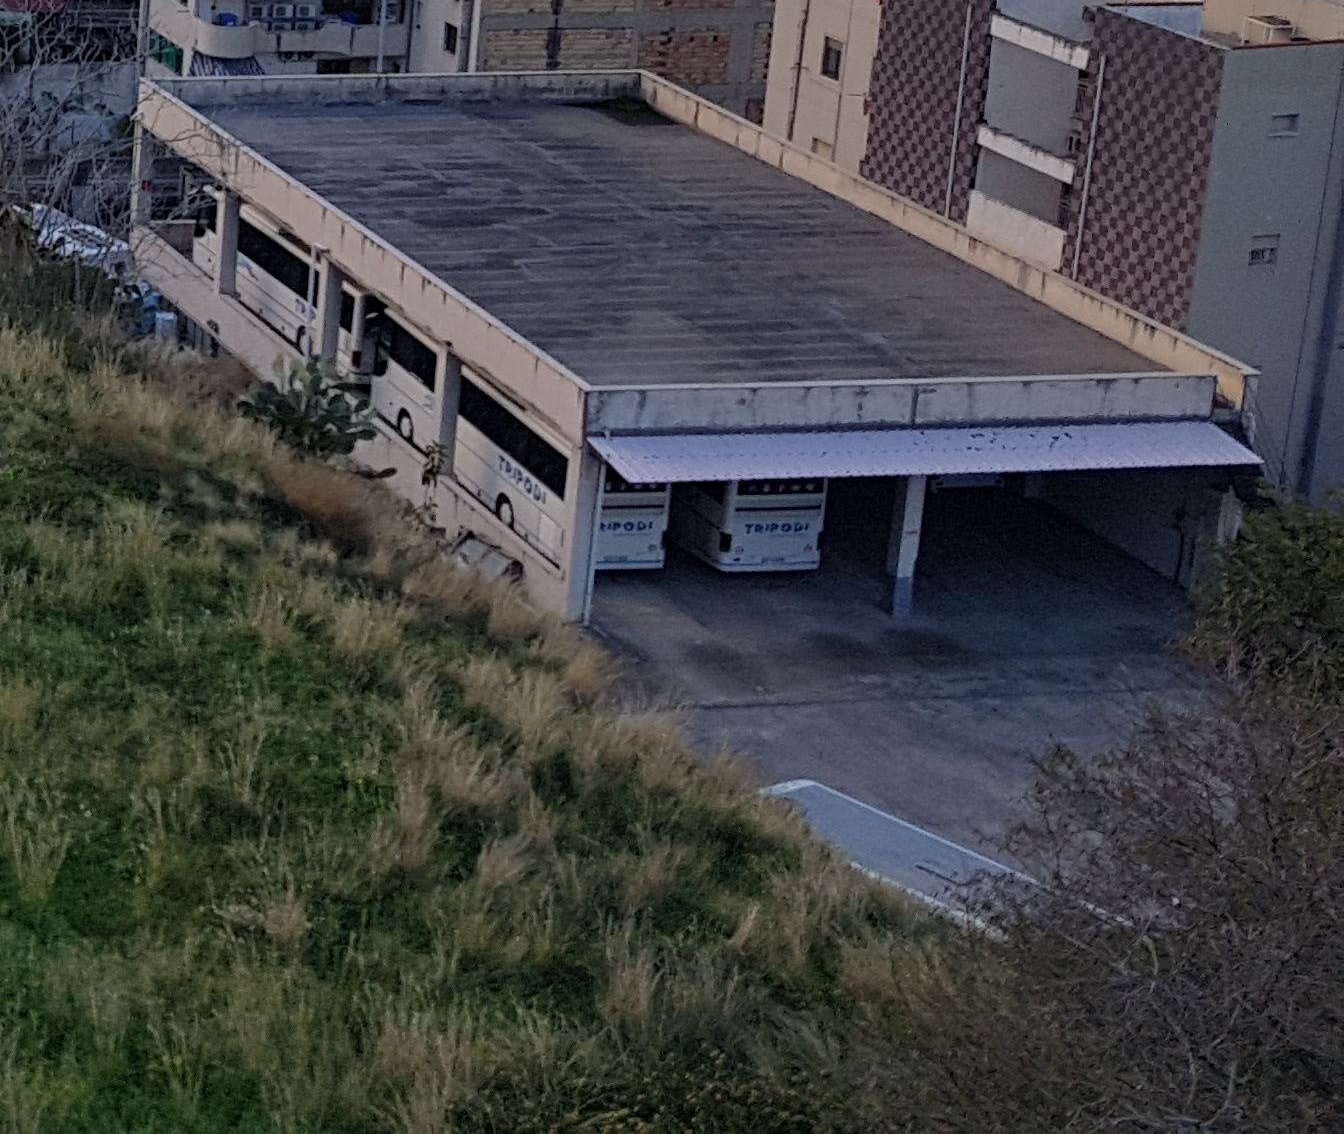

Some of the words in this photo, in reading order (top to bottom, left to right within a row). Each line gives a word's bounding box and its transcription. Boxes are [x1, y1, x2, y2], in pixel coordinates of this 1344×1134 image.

[498, 455, 547, 504] TRIPODI
[600, 521, 653, 532] RIPODI
[744, 522, 810, 534] TRIPODI
